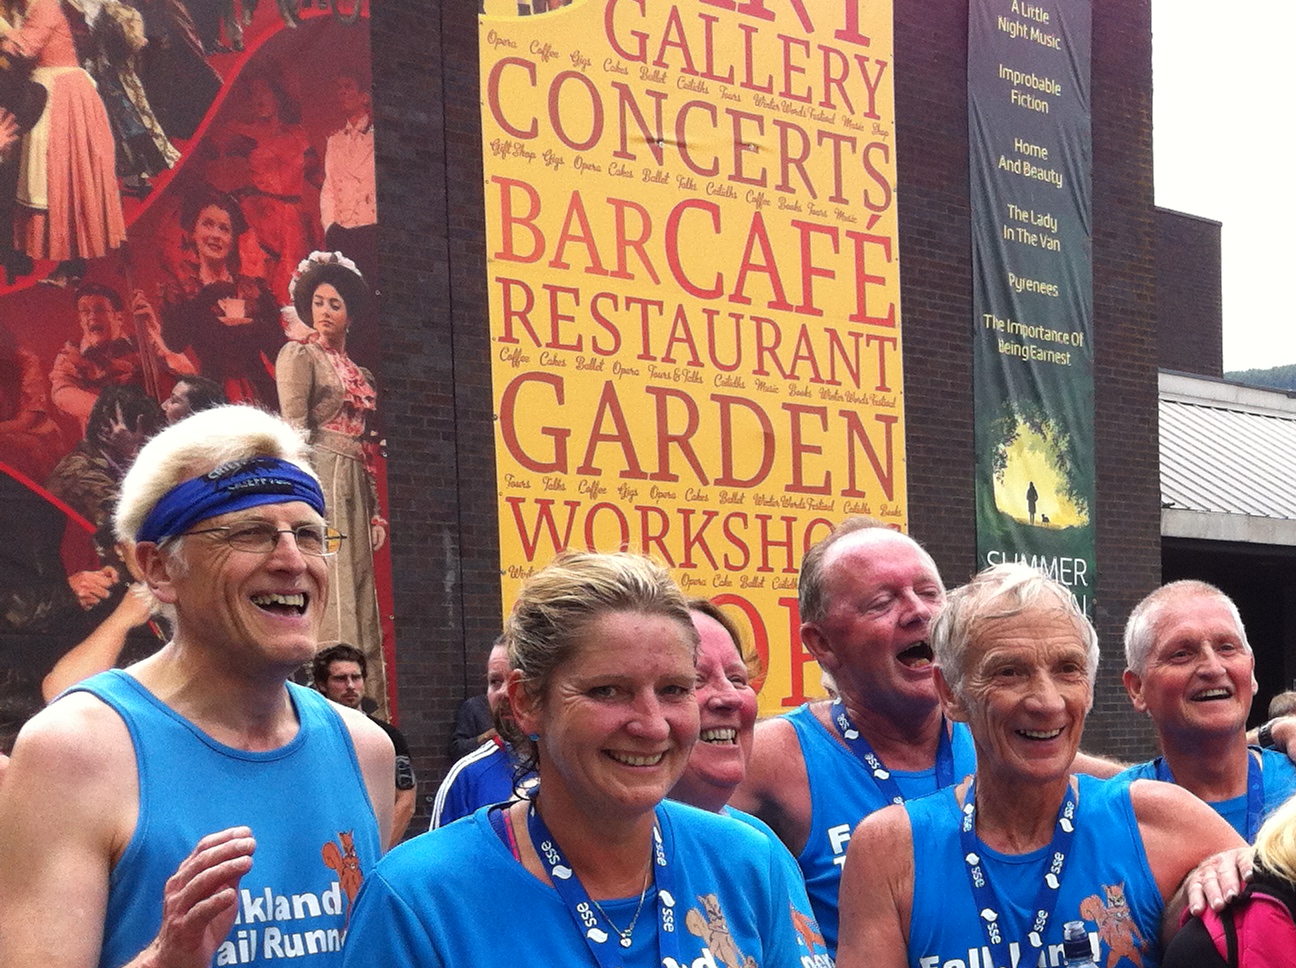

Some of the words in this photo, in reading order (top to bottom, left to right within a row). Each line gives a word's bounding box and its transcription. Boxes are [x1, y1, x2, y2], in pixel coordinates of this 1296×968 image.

[1021, 1, 1050, 24] Little
[997, 15, 1028, 40] Night
[1029, 26, 1061, 51] Music
[487, 29, 517, 49] Opera
[529, 40, 560, 62] Coffee
[603, 58, 628, 75] Cakes
[603, 0, 888, 120] GALLERY
[998, 63, 1062, 97] Improbable
[1010, 89, 1049, 114] Fiction
[487, 57, 892, 212] CONCERTS
[1014, 138, 1048, 161] Home
[573, 155, 601, 175] Opera
[642, 168, 670, 185] Ballet
[746, 189, 771, 210] Coffee
[998, 155, 1021, 175] And
[1023, 161, 1063, 188] Beauty
[1007, 203, 1029, 223] The
[1030, 208, 1058, 233] Lady
[1003, 225, 1015, 240] In
[1016, 228, 1037, 247] The
[1039, 233, 1061, 252] Van
[1008, 272, 1059, 297] Pyrenees
[495, 277, 898, 392] RESTAURANT
[983, 314, 1005, 333] The
[1007, 319, 1069, 345] Importance
[1071, 331, 1084, 347] Of
[500, 347, 530, 368] Coffee
[539, 351, 566, 367] Cakes
[575, 356, 604, 372] Ballet
[612, 361, 640, 380] Opera
[500, 371, 898, 501] GARDEN
[578, 479, 607, 500] Coffee
[650, 485, 677, 504] Opera
[681, 572, 707, 591] Opera
[576, 901, 597, 927] sse
[662, 907, 674, 932] sse
[1034, 909, 1048, 932] sse
[987, 922, 1002, 945] sse
